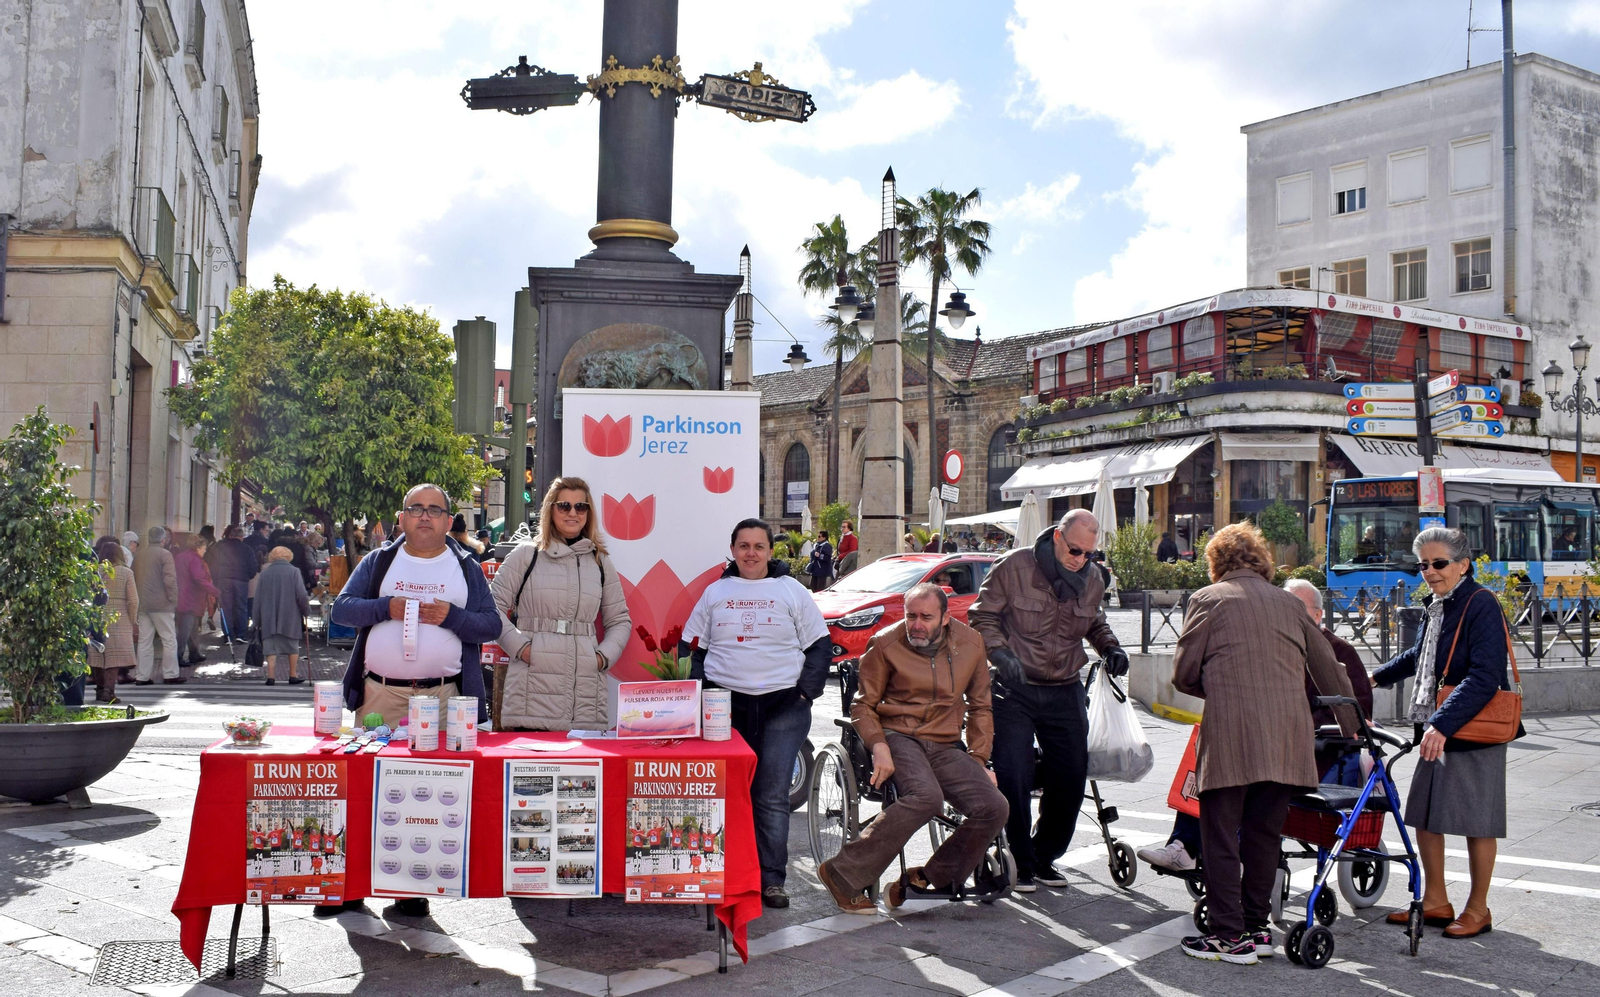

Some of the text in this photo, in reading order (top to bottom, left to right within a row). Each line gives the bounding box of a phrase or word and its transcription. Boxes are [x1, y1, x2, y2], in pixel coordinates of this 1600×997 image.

[725, 84, 784, 104] CADIZ
[642, 415, 742, 435] Parkinson
[639, 436, 688, 458] Jerez
[1346, 481, 1415, 498] 3 LAS TORRES
[254, 763, 338, 779] II RUN FOR
[634, 762, 716, 778] II RUN FOR
[304, 784, 338, 797] JEREZ
[684, 783, 716, 796] JEREZ
[405, 816, 439, 825] SÍNTOMAS
